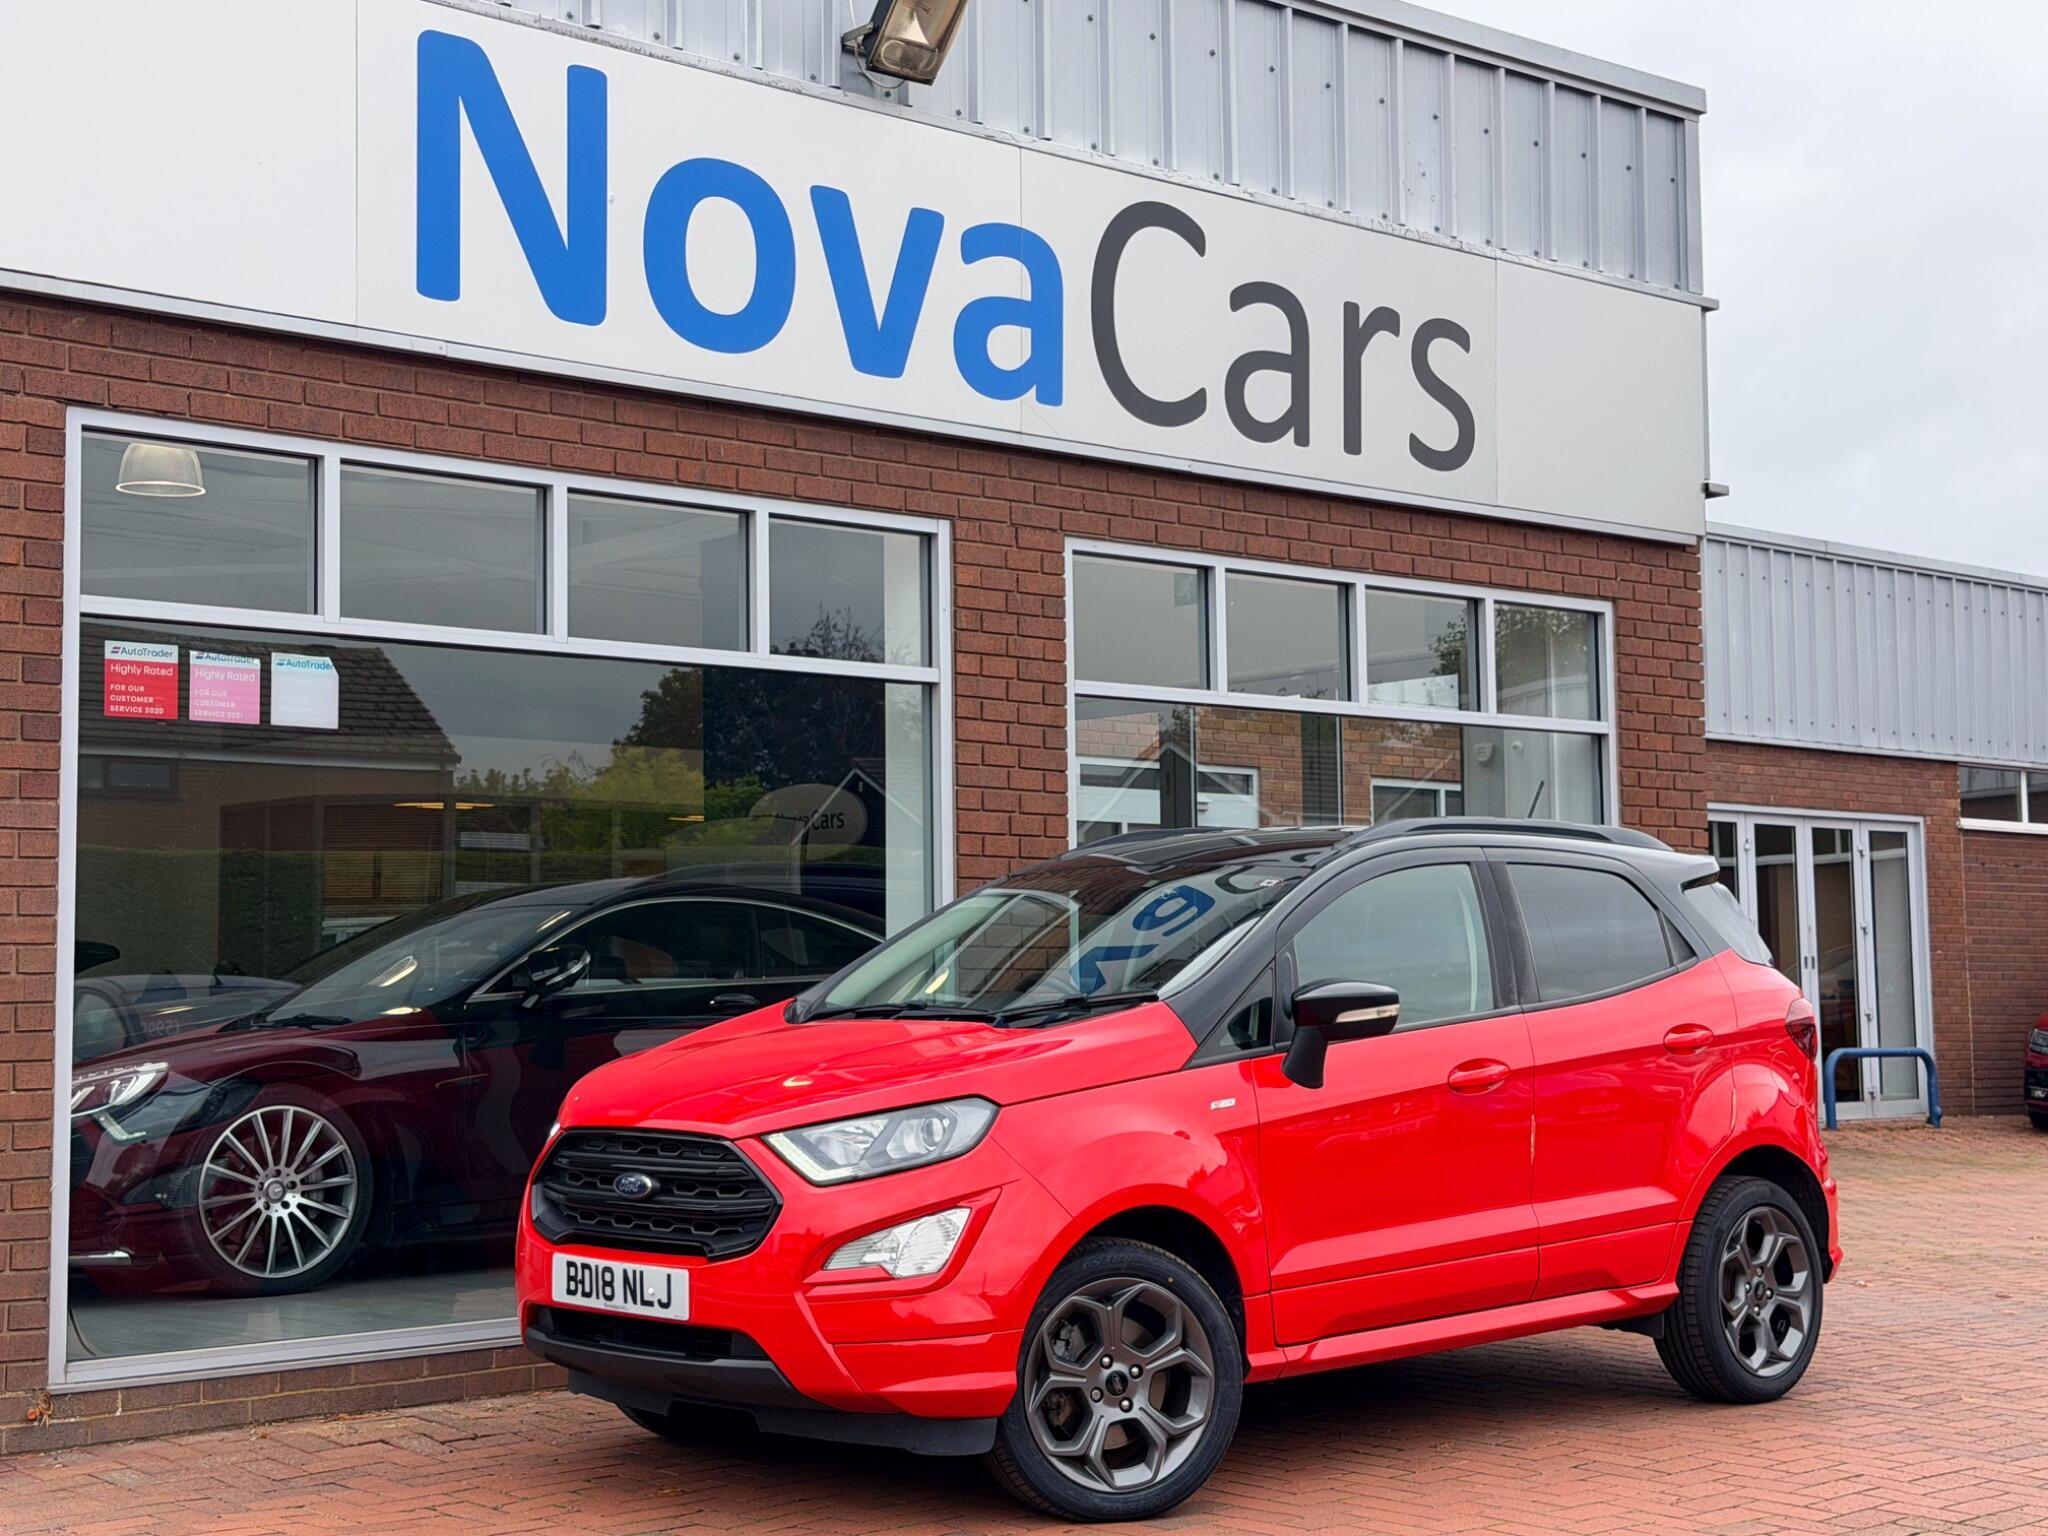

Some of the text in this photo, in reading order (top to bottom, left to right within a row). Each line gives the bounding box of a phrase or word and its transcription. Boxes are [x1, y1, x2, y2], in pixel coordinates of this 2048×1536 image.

[417, 31, 1475, 471] NovaCars
[120, 646, 174, 658] AutoTrader
[110, 663, 173, 677] Highly Rated
[194, 669, 255, 682] Highly Rated
[109, 683, 126, 691] FOR
[109, 694, 154, 703] CUSTOMER
[194, 699, 236, 708] CUSTOMER
[109, 704, 164, 715] SERVICE 2020
[193, 709, 225, 718] SERVICE
[566, 1260, 671, 1309] BD18 NLJ
